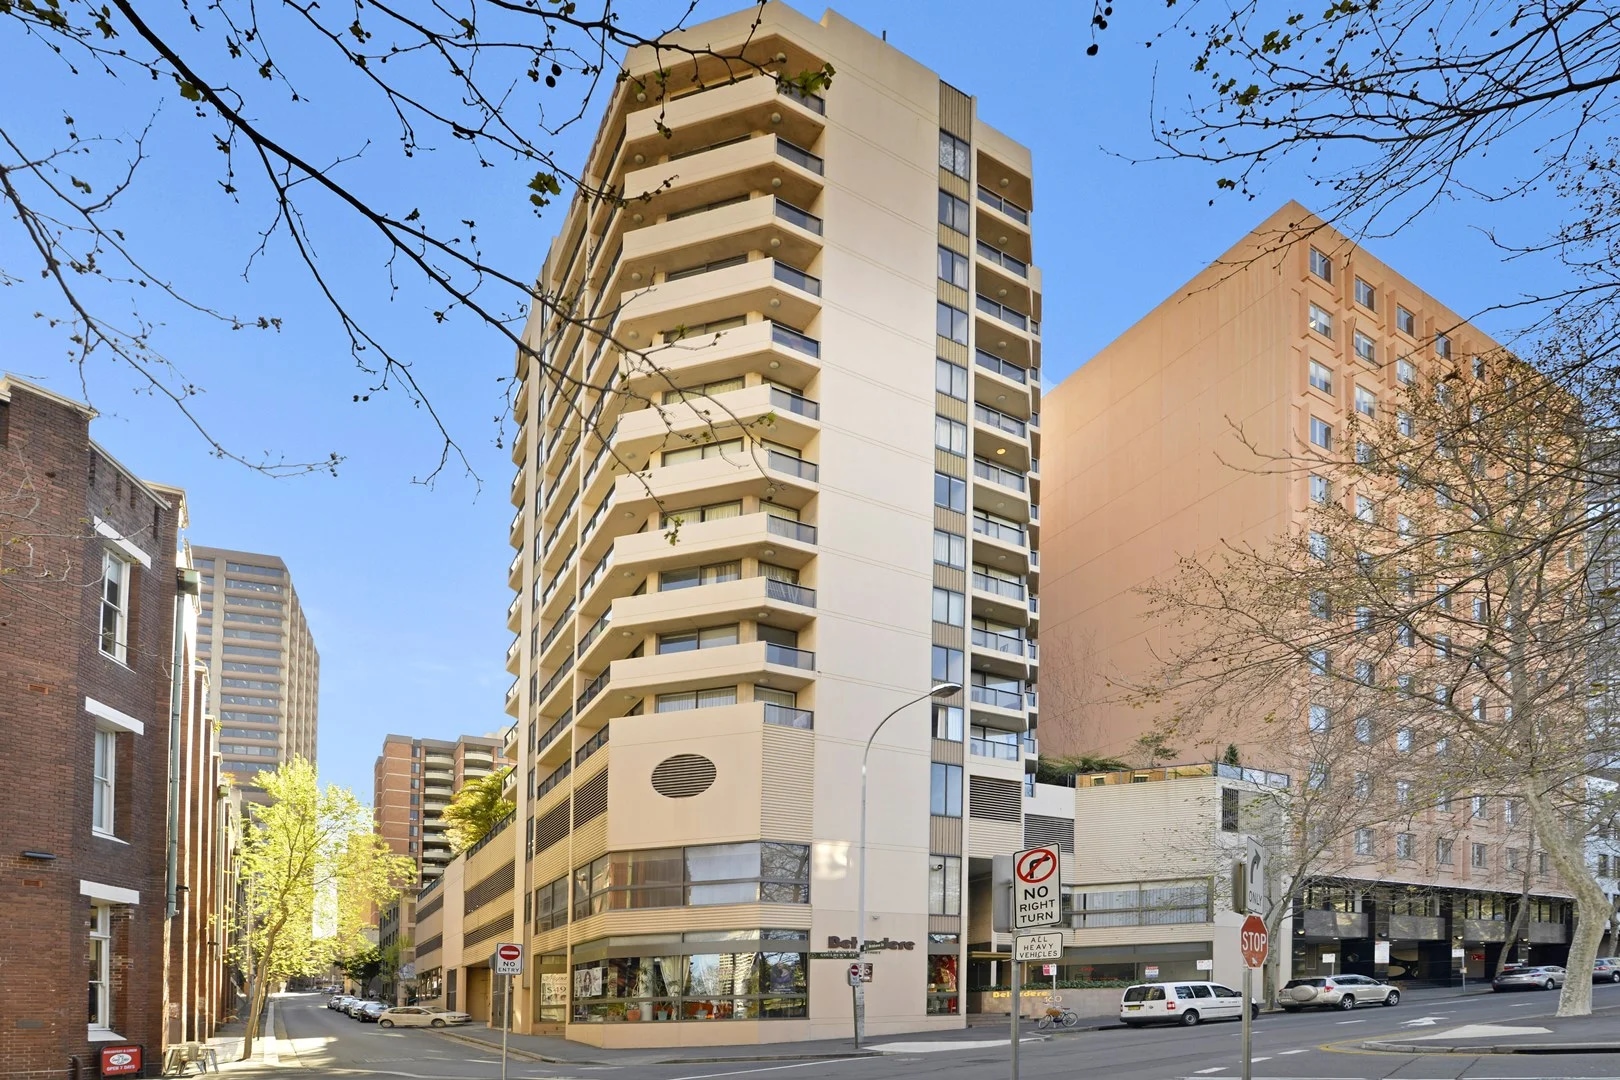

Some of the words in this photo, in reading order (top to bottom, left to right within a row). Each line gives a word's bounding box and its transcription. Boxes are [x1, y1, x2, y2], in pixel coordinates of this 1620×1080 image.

[1024, 886, 1048, 900] NO
[1249, 890, 1262, 906] ONLY
[1020, 899, 1055, 912] RIGHT
[1020, 911, 1053, 923] TURN
[828, 936, 915, 950] Beldere
[1023, 943, 1053, 951] HEAVY
[1242, 931, 1267, 952] STOP
[1019, 950, 1058, 958] VEHICLES
[992, 990, 1049, 998] Beldere
